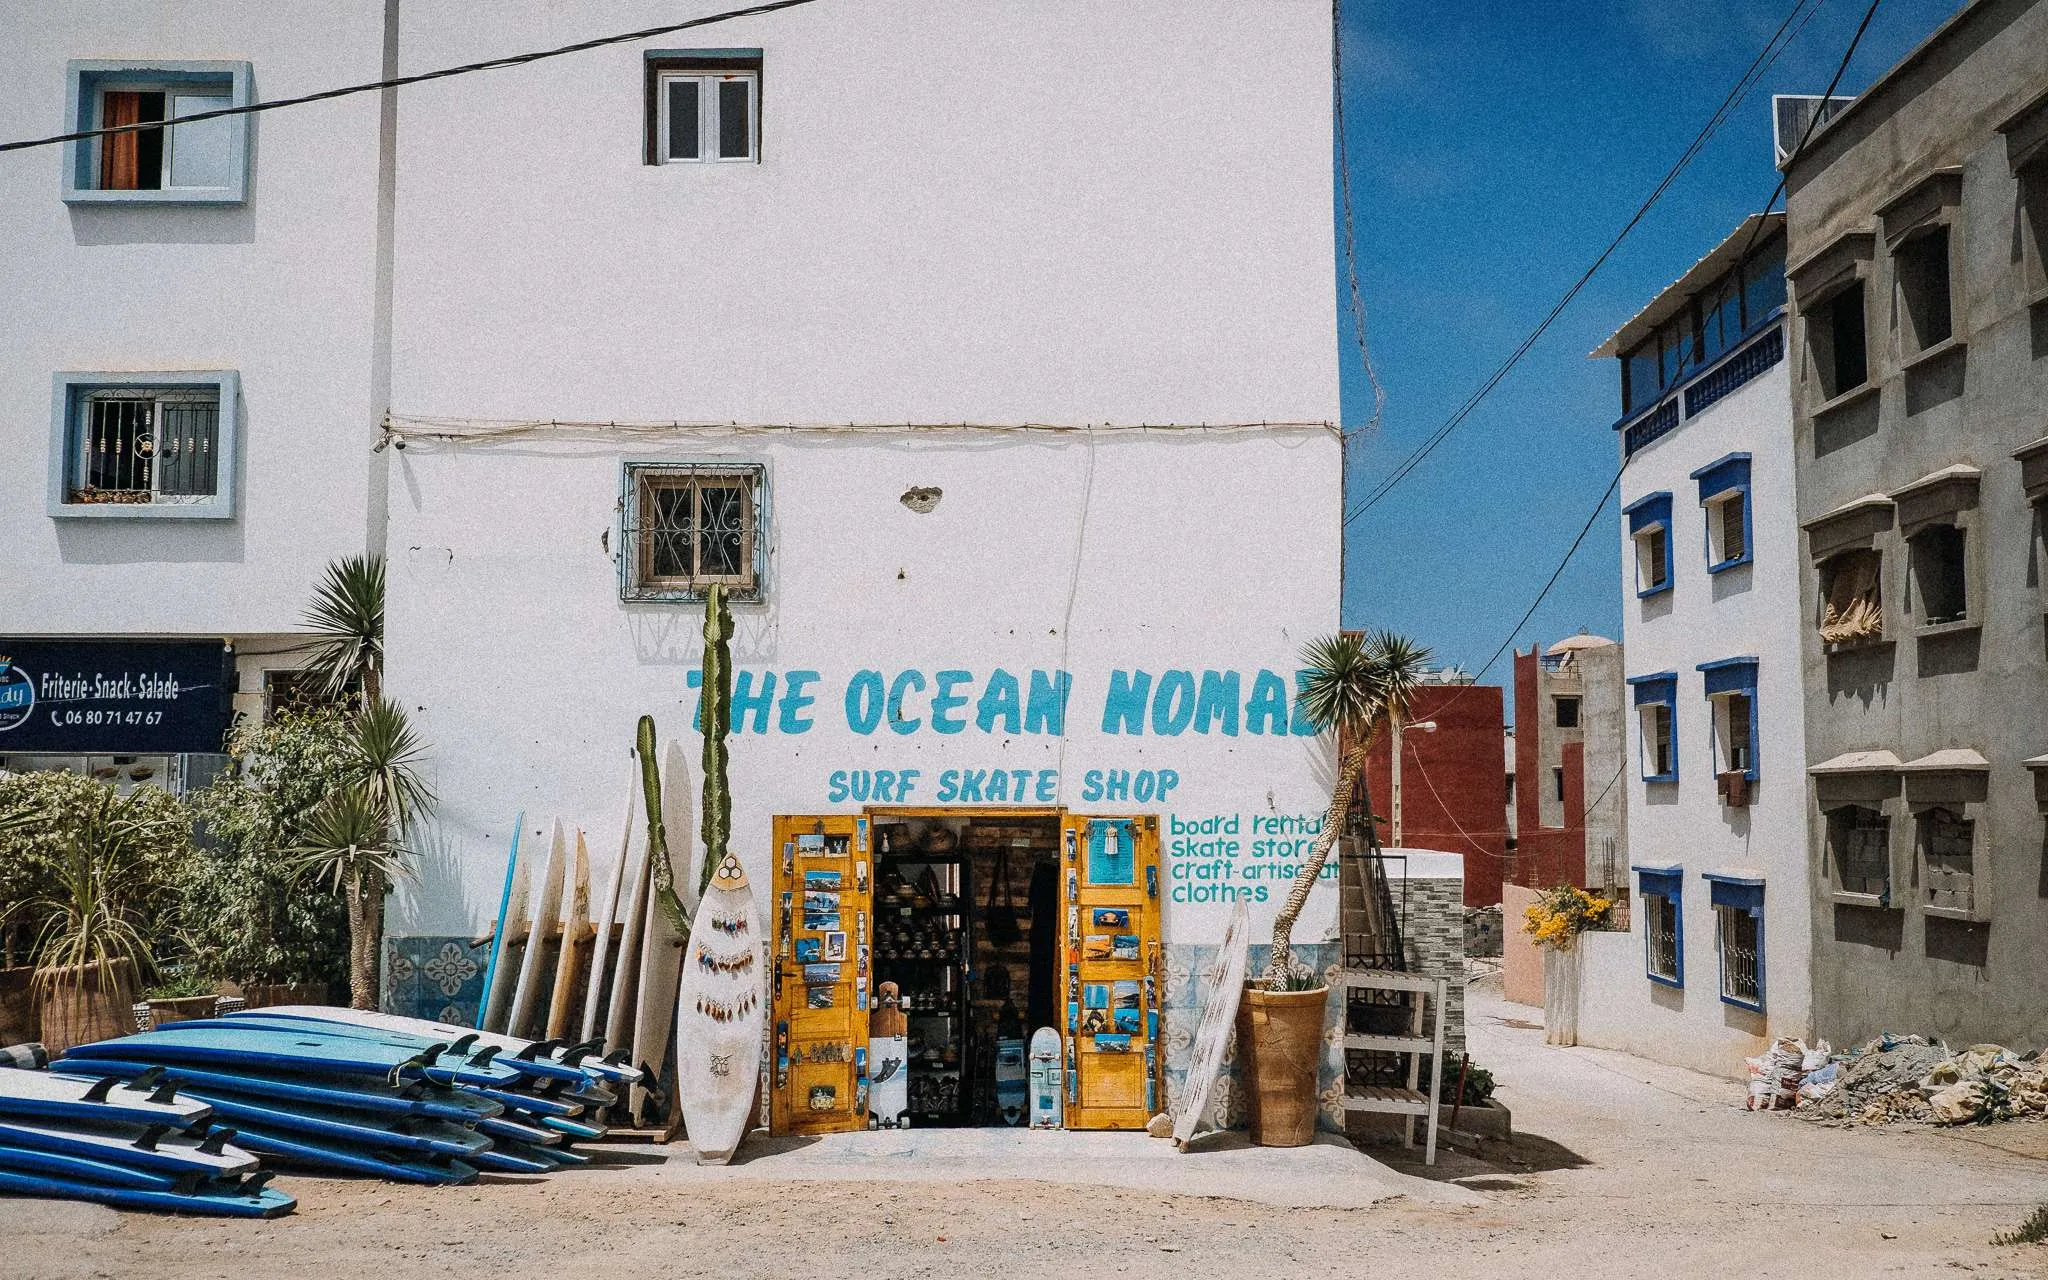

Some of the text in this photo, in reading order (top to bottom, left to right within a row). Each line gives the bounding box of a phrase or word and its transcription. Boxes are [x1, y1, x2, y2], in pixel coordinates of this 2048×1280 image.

[94, 671, 131, 699] Snack
[138, 672, 179, 700] Salade
[844, 667, 1073, 737] OCEAN
[65, 710, 163, 725] 06 80 71 47 67
[828, 768, 1180, 804] SURF SKATE SHOP
[1170, 813, 1239, 836] board
[1170, 837, 1240, 858] skate
[1171, 882, 1270, 903] clothes
